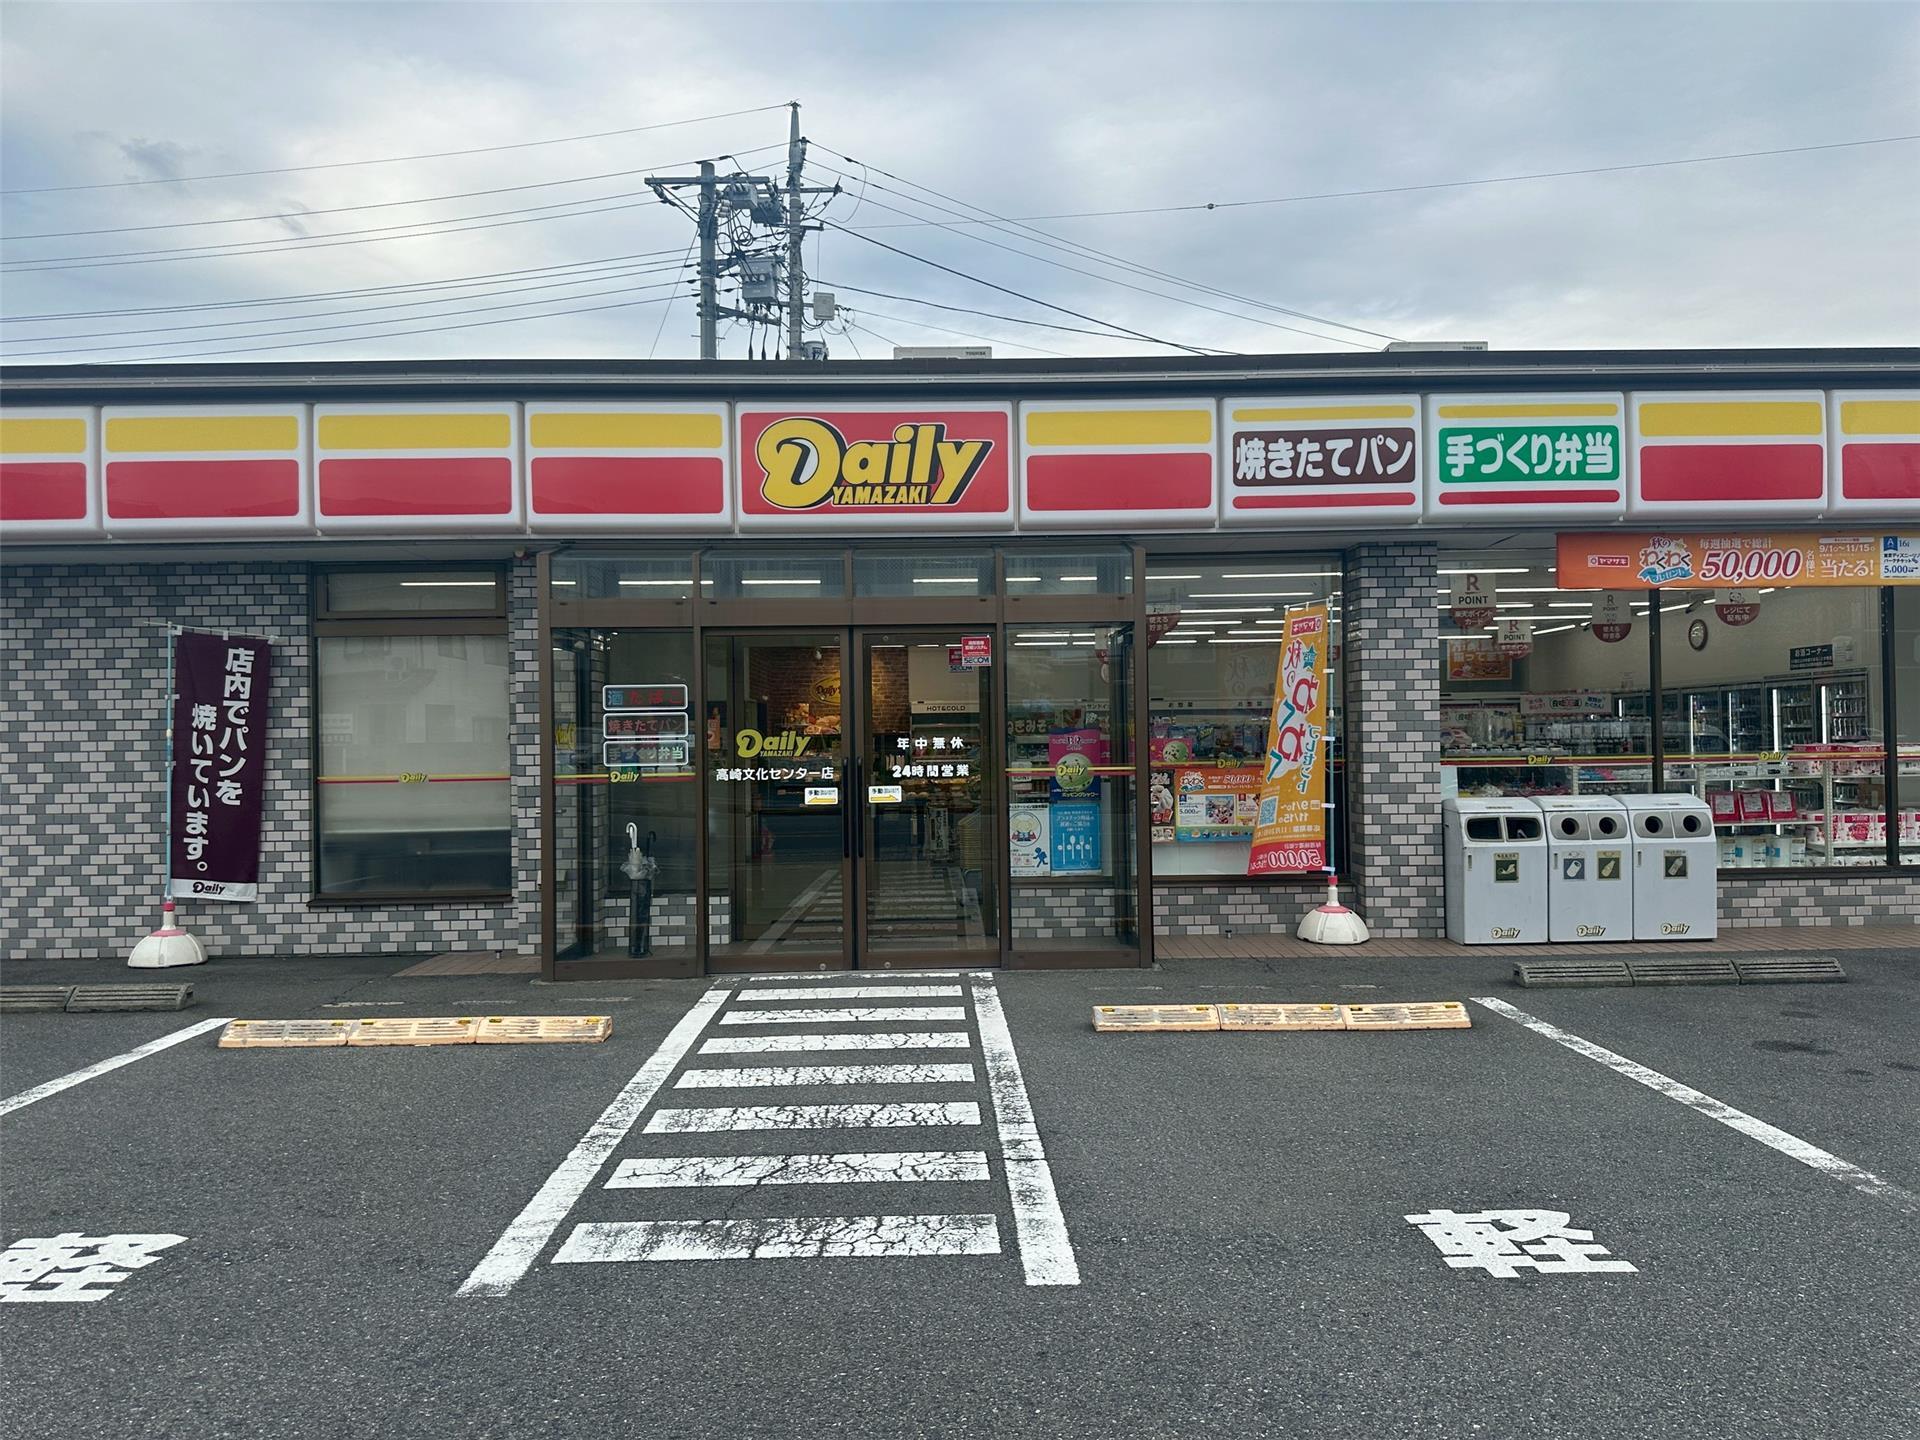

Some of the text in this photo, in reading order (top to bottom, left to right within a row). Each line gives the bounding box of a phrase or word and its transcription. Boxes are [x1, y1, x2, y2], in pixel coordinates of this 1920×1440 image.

[1236, 434, 1414, 480] 焼きたてパン
[1445, 431, 1614, 477] 手づくり弁当
[758, 418, 993, 508] Daily
[832, 485, 928, 505] YAMAZAKI
[1651, 538, 1672, 549] 秋の
[1599, 557, 1627, 565] ヤマザキ
[1641, 550, 1692, 570] わくわく
[1700, 549, 1803, 584] 50,000
[1466, 574, 1480, 591] R
[1458, 596, 1488, 605] POINT
[1607, 595, 1614, 604] R
[1723, 606, 1752, 614] レジにて
[1507, 620, 1519, 632] R
[1504, 633, 1526, 641] POINT
[963, 656, 990, 664] SECOM
[215, 647, 255, 806] 店内でパンを
[607, 719, 681, 733] 焼きたてパン
[736, 729, 812, 758] Daily
[896, 736, 964, 750] 年中無休
[608, 745, 684, 760] 手づくり弁当
[1527, 755, 1553, 764] Daily
[1759, 752, 1785, 761] Daily
[1056, 763, 1085, 776] Daily
[1217, 759, 1242, 768] Daily
[400, 773, 428, 783] Daily
[610, 770, 640, 783] Daily
[716, 766, 835, 781] 高崎文化センター店
[892, 764, 970, 778] 24時間営業
[183, 702, 217, 872] 焼いています。
[192, 881, 226, 895] Daily
[1491, 927, 1520, 939] Daily
[1576, 924, 1606, 938] Daily
[1661, 922, 1690, 936] Daily
[1403, 1209, 1640, 1278] 軽
